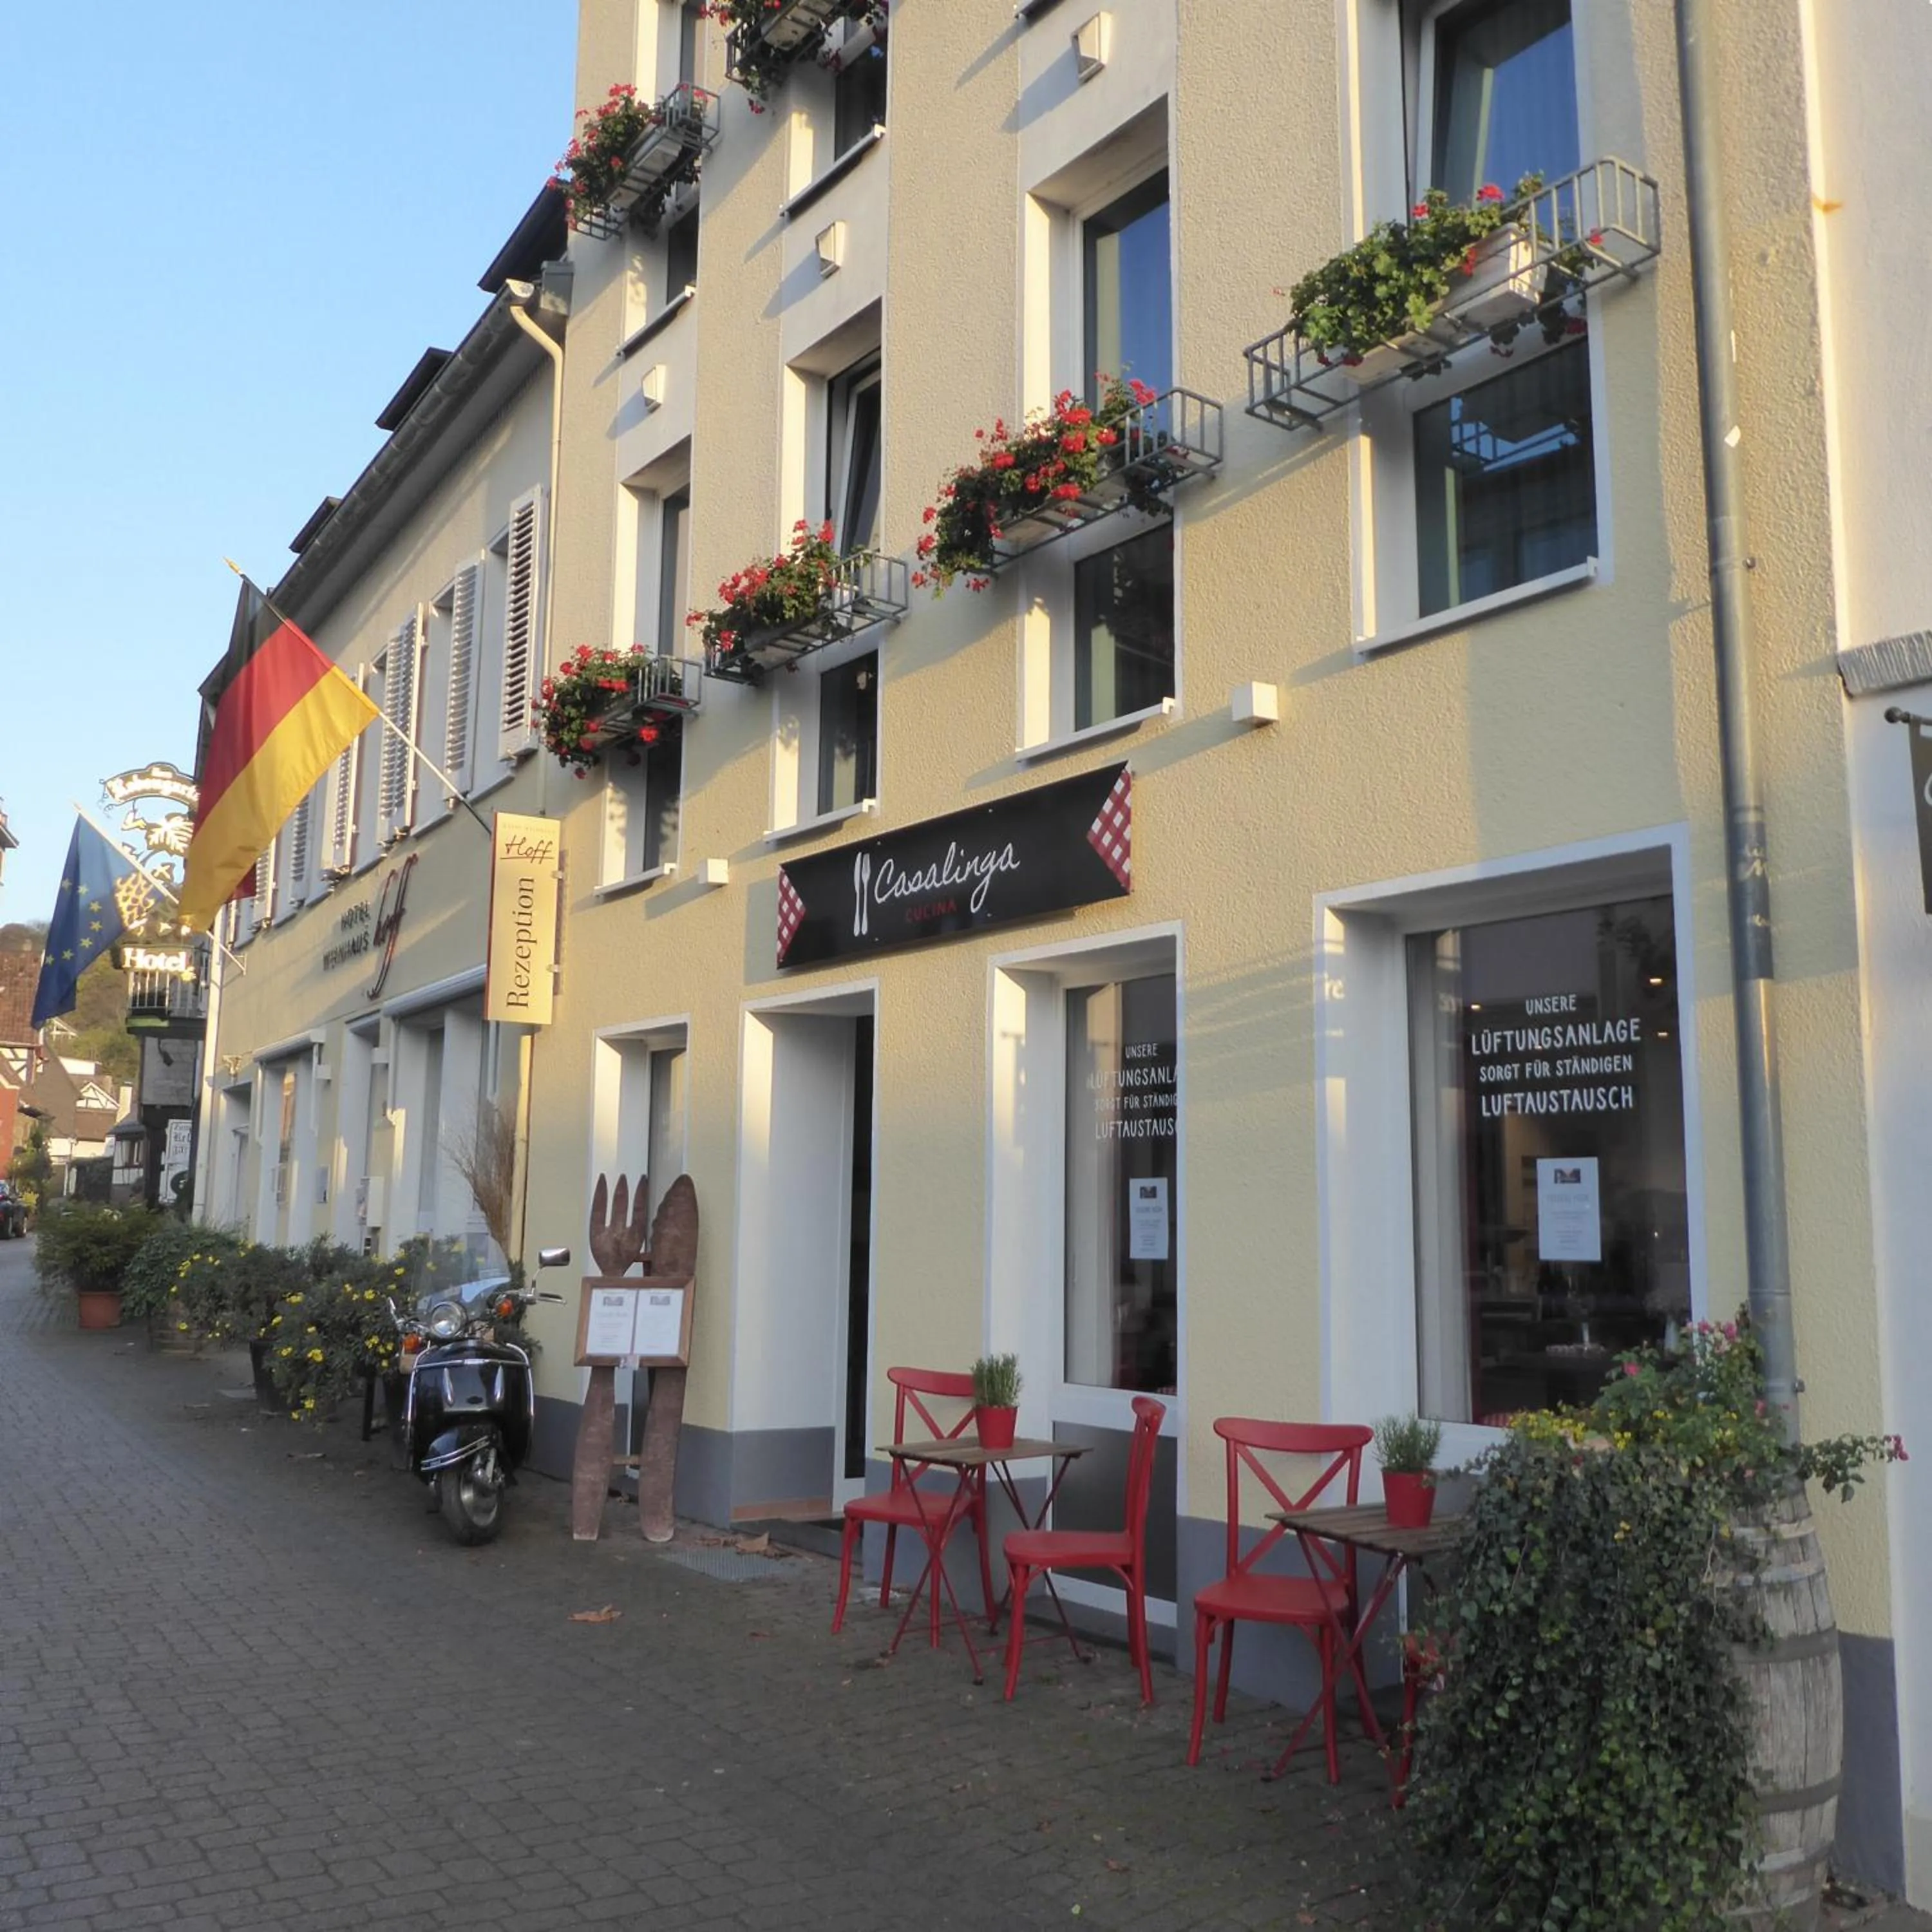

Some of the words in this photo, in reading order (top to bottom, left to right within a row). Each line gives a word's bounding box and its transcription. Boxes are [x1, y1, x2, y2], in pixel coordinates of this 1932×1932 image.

[505, 835, 553, 864] Hoff
[875, 842, 1020, 913] Casalinga
[905, 900, 958, 922] CUCINA
[507, 876, 537, 1008] Rezeption
[122, 947, 186, 972] Hotel
[1526, 994, 1577, 1015] UNSERE
[1125, 1043, 1159, 1059] UNSERE
[1472, 1018, 1642, 1056] LÜFTUNGSANLAGE
[1479, 1063, 1520, 1083] SORGT
[1525, 1059, 1551, 1079] FÜR
[1556, 1054, 1633, 1076] STÄNDIGEN
[1124, 1094, 1141, 1110] FÜR
[1482, 1085, 1634, 1118] LUFTAUSTAUSCH
